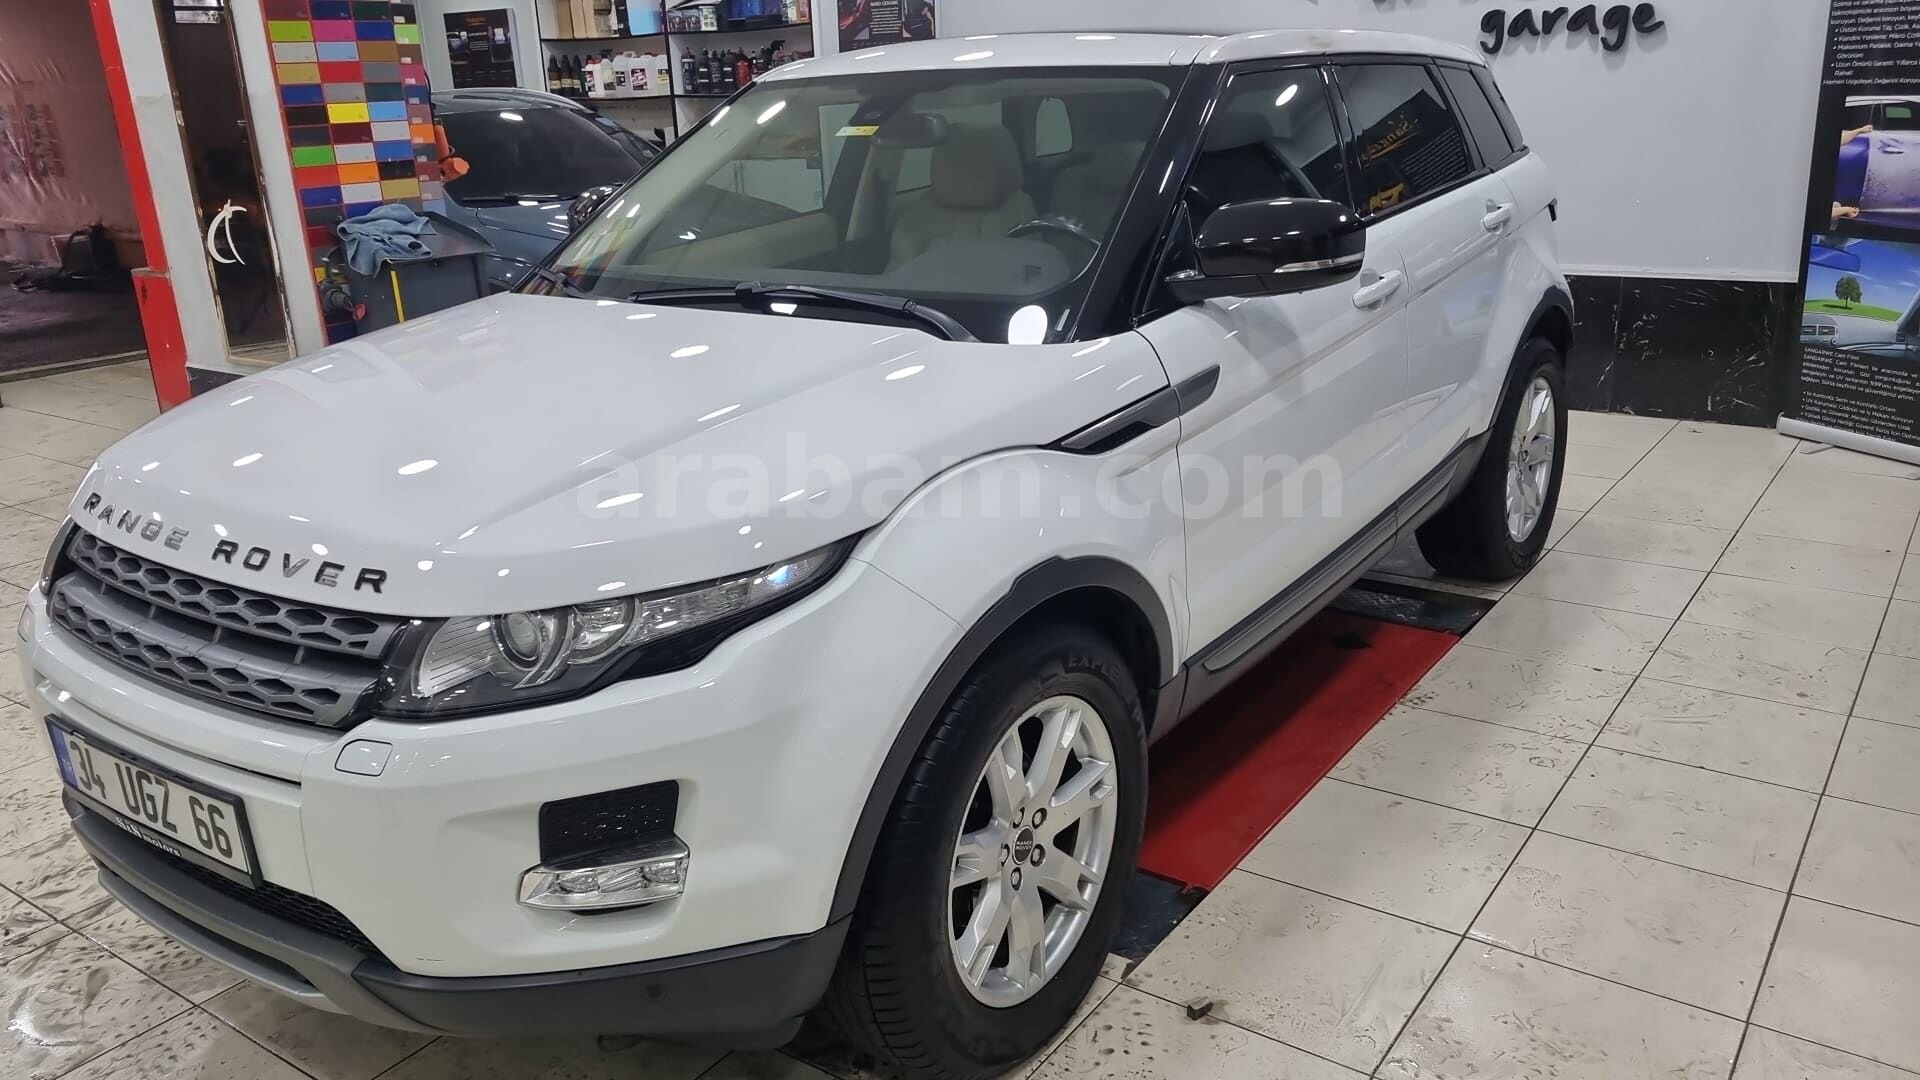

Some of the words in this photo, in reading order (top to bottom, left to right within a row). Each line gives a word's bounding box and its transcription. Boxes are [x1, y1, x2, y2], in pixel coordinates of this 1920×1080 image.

[1479, 3, 1665, 54] garage
[83, 492, 189, 551] RANGE
[211, 539, 387, 594] ROVER
[69, 740, 107, 800] 34
[114, 762, 178, 834] UGZ
[188, 795, 233, 859] 66
